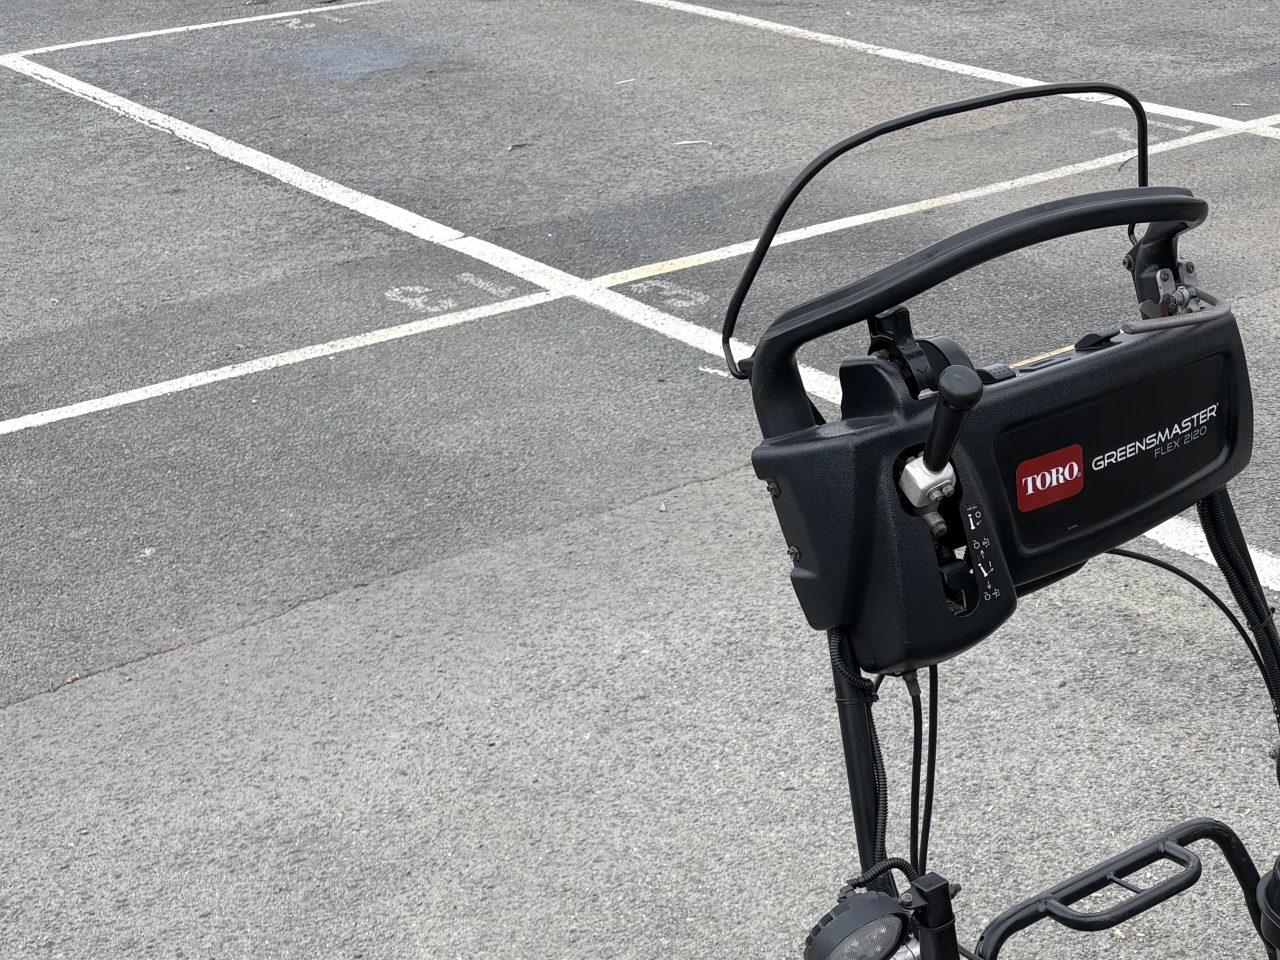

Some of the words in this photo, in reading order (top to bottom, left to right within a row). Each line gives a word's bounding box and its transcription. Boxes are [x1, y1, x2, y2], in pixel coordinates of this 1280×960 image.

[1022, 461, 1079, 495] TORO
[1091, 404, 1217, 471] GREENSMASTER
[1154, 440, 1180, 459] FLEX
[1183, 425, 1208, 444] 2120
